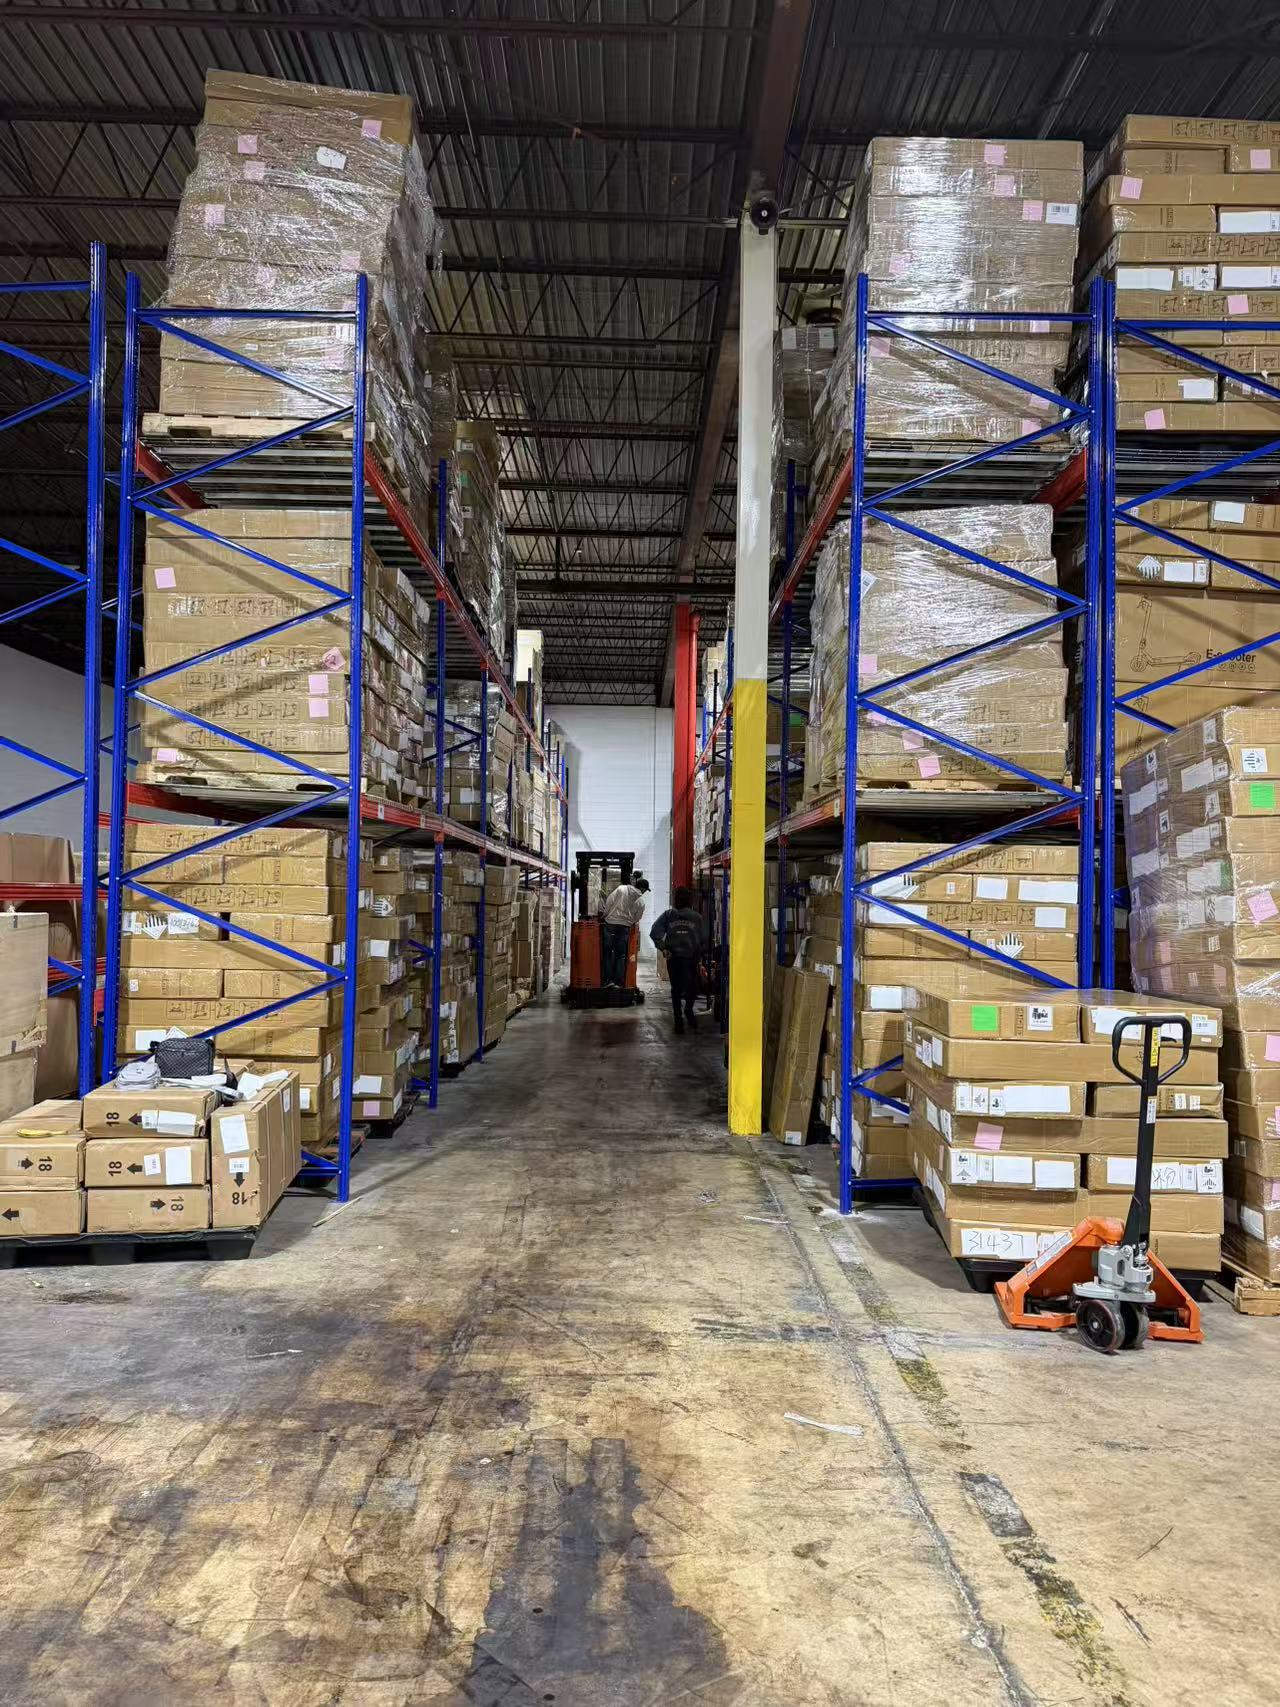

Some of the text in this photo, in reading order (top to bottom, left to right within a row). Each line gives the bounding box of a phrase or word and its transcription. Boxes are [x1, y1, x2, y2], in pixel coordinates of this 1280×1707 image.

[106, 1112, 120, 1127] 18
[38, 1156, 53, 1171] 18
[108, 1161, 122, 1176] 18
[170, 1196, 184, 1211] 18
[232, 1192, 247, 1205] 18
[968, 1230, 1024, 1256] 31437
